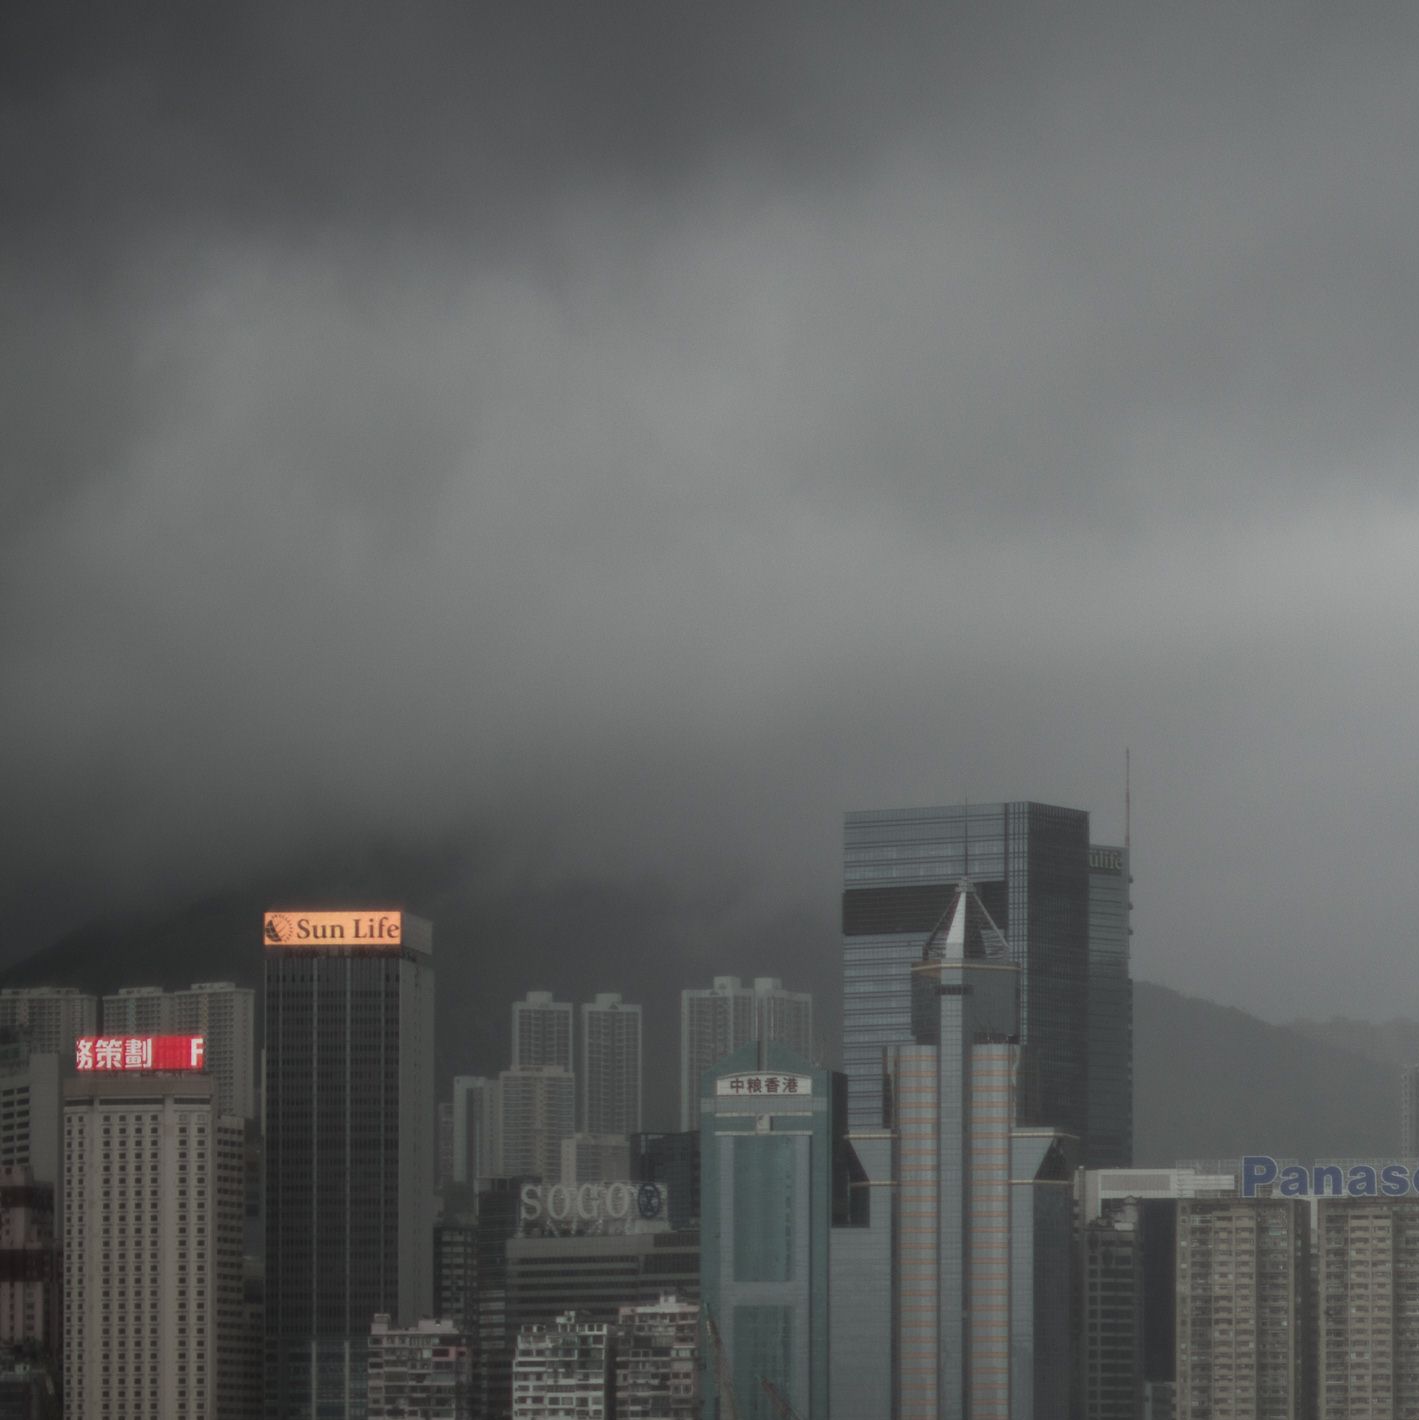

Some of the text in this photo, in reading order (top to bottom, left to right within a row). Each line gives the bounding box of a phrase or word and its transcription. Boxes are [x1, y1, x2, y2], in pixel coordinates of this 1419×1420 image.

[297, 917, 401, 942] Sun Life
[729, 1077, 800, 1094] 中粮香港
[521, 1183, 630, 1220] SOGO
